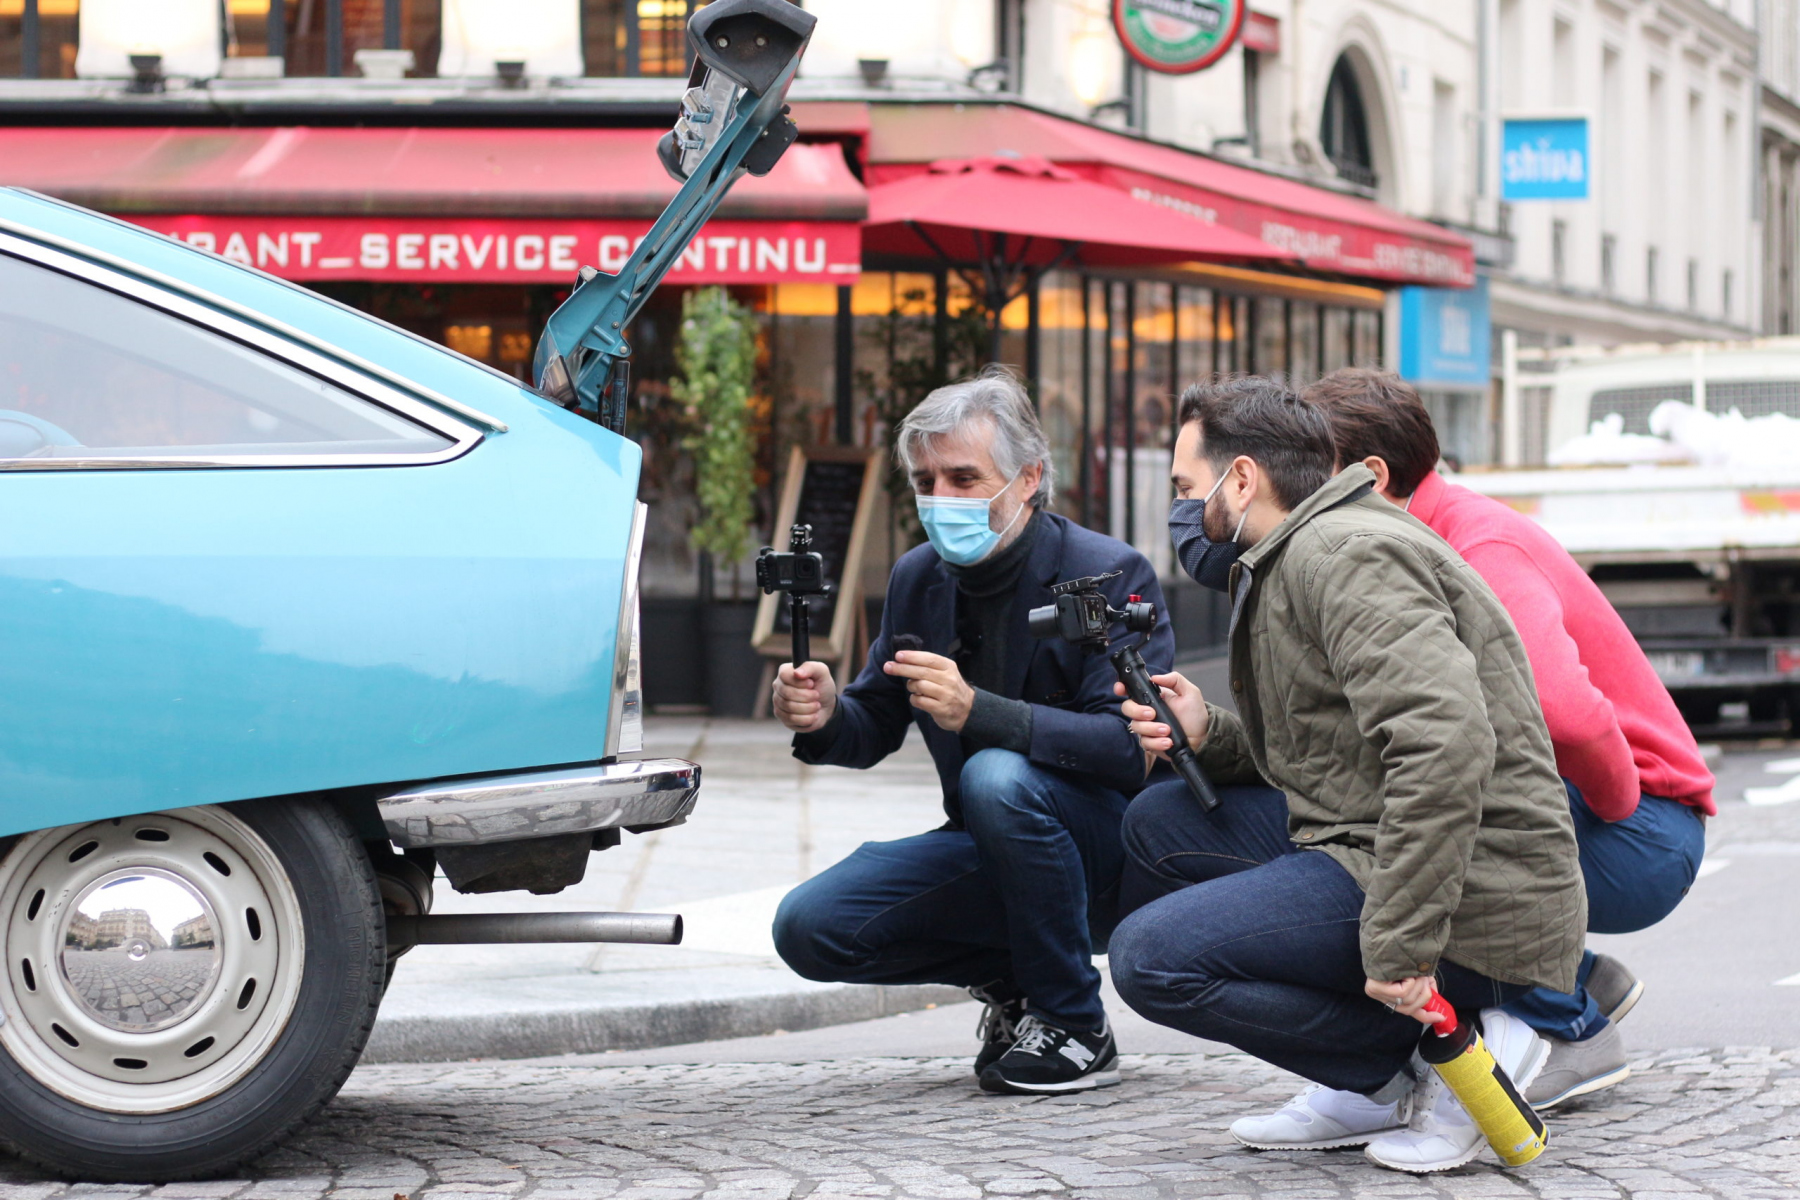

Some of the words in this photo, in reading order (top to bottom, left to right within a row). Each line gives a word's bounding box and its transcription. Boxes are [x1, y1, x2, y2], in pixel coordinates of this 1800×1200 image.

[1506, 138, 1583, 182] shiva
[359, 233, 578, 271] SERVICE
[1058, 1037, 1096, 1071] N
